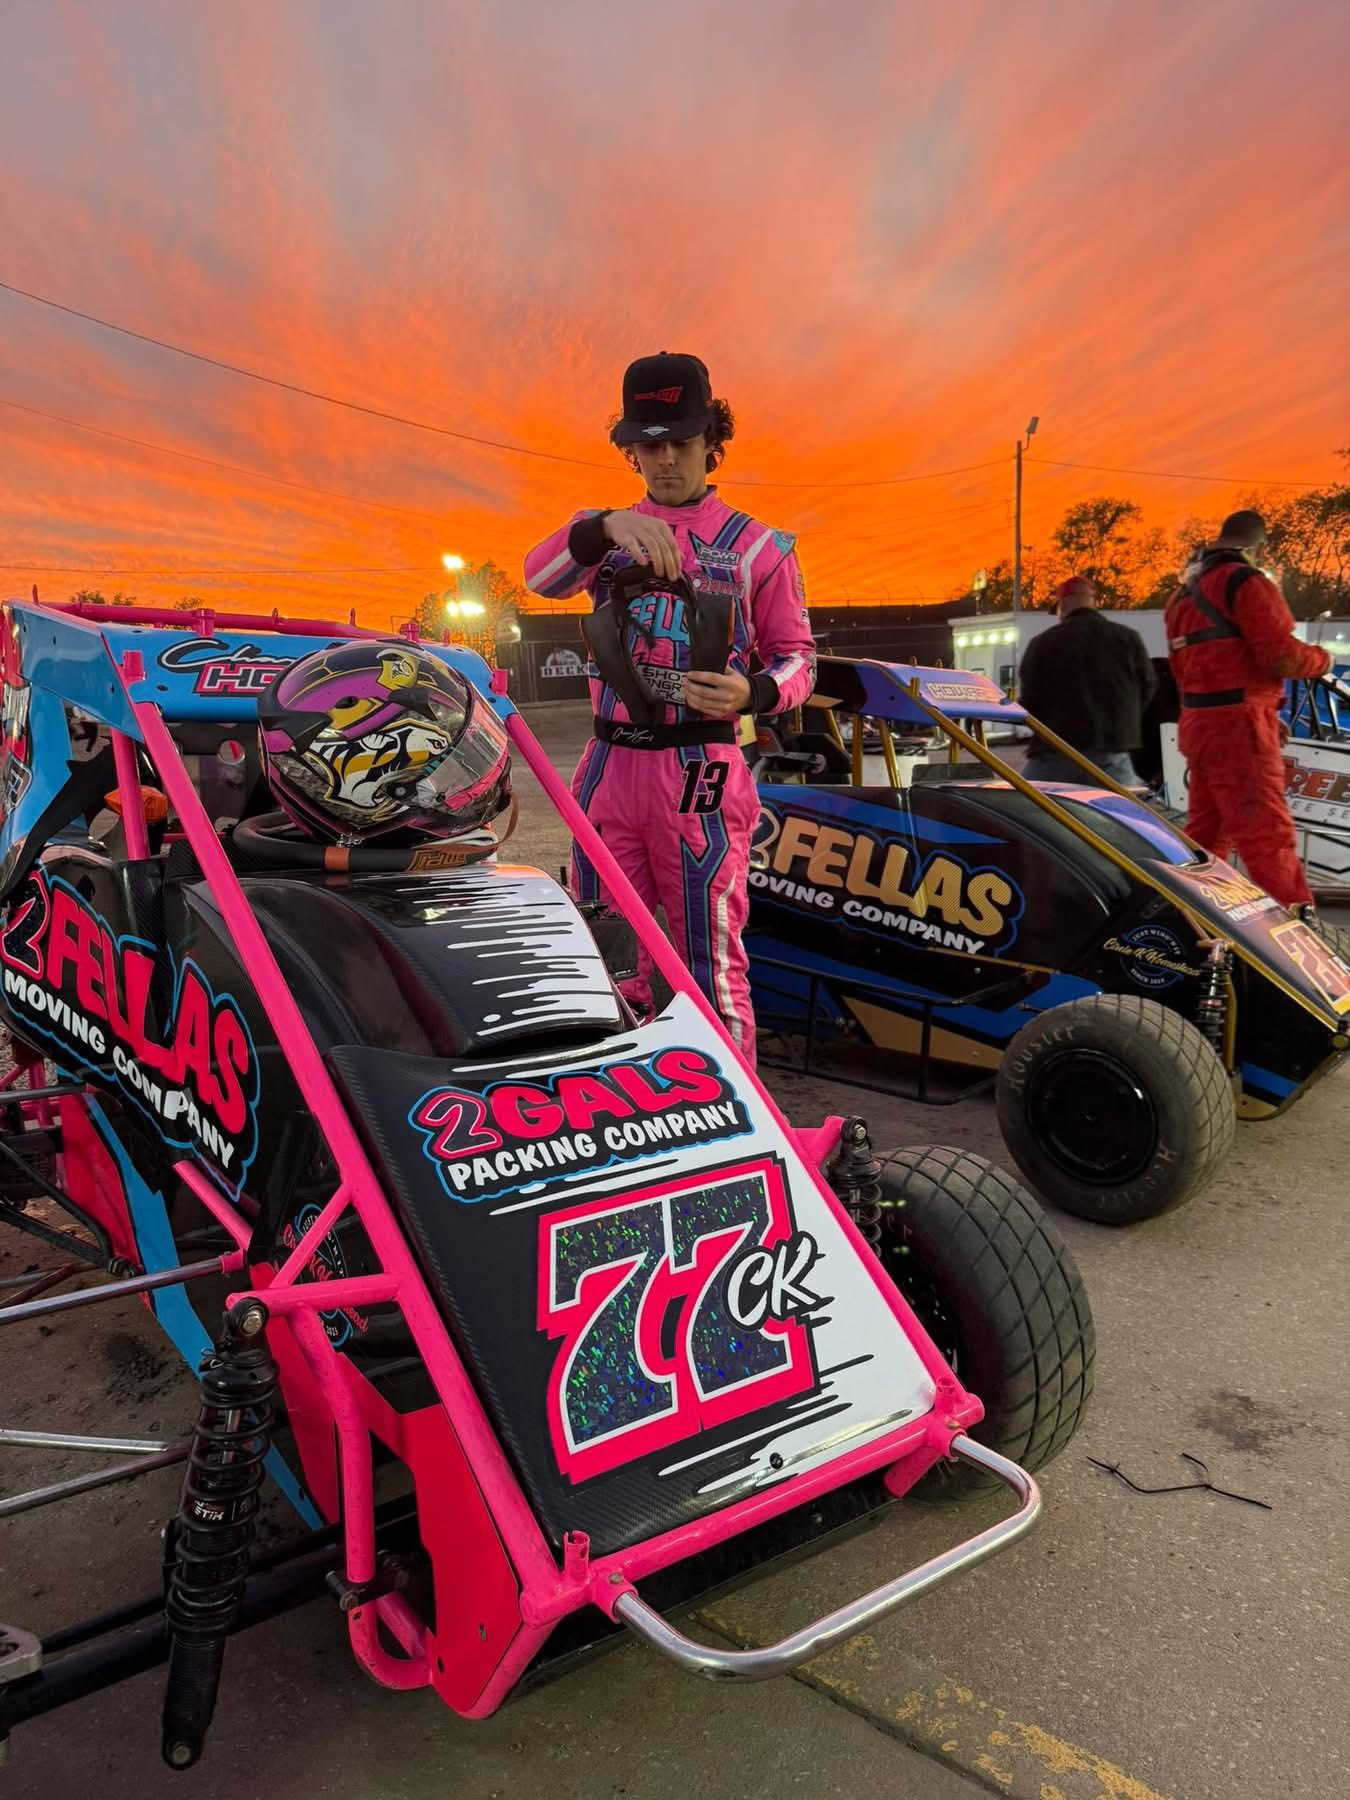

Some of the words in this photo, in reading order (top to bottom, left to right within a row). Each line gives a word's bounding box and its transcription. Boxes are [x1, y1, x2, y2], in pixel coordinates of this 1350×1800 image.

[628, 594, 691, 646] FELL
[643, 667, 688, 683] SHO
[677, 758, 731, 815] 13
[747, 870, 835, 909] OVING
[842, 899, 986, 956] COMPANY
[4, 968, 107, 1055] MOVING
[112, 1045, 235, 1169] COMPANY
[447, 1134, 597, 1191] PACKING
[603, 1101, 741, 1150] COMPANY
[537, 1158, 813, 1484] 77
[727, 1236, 818, 1328] CK
